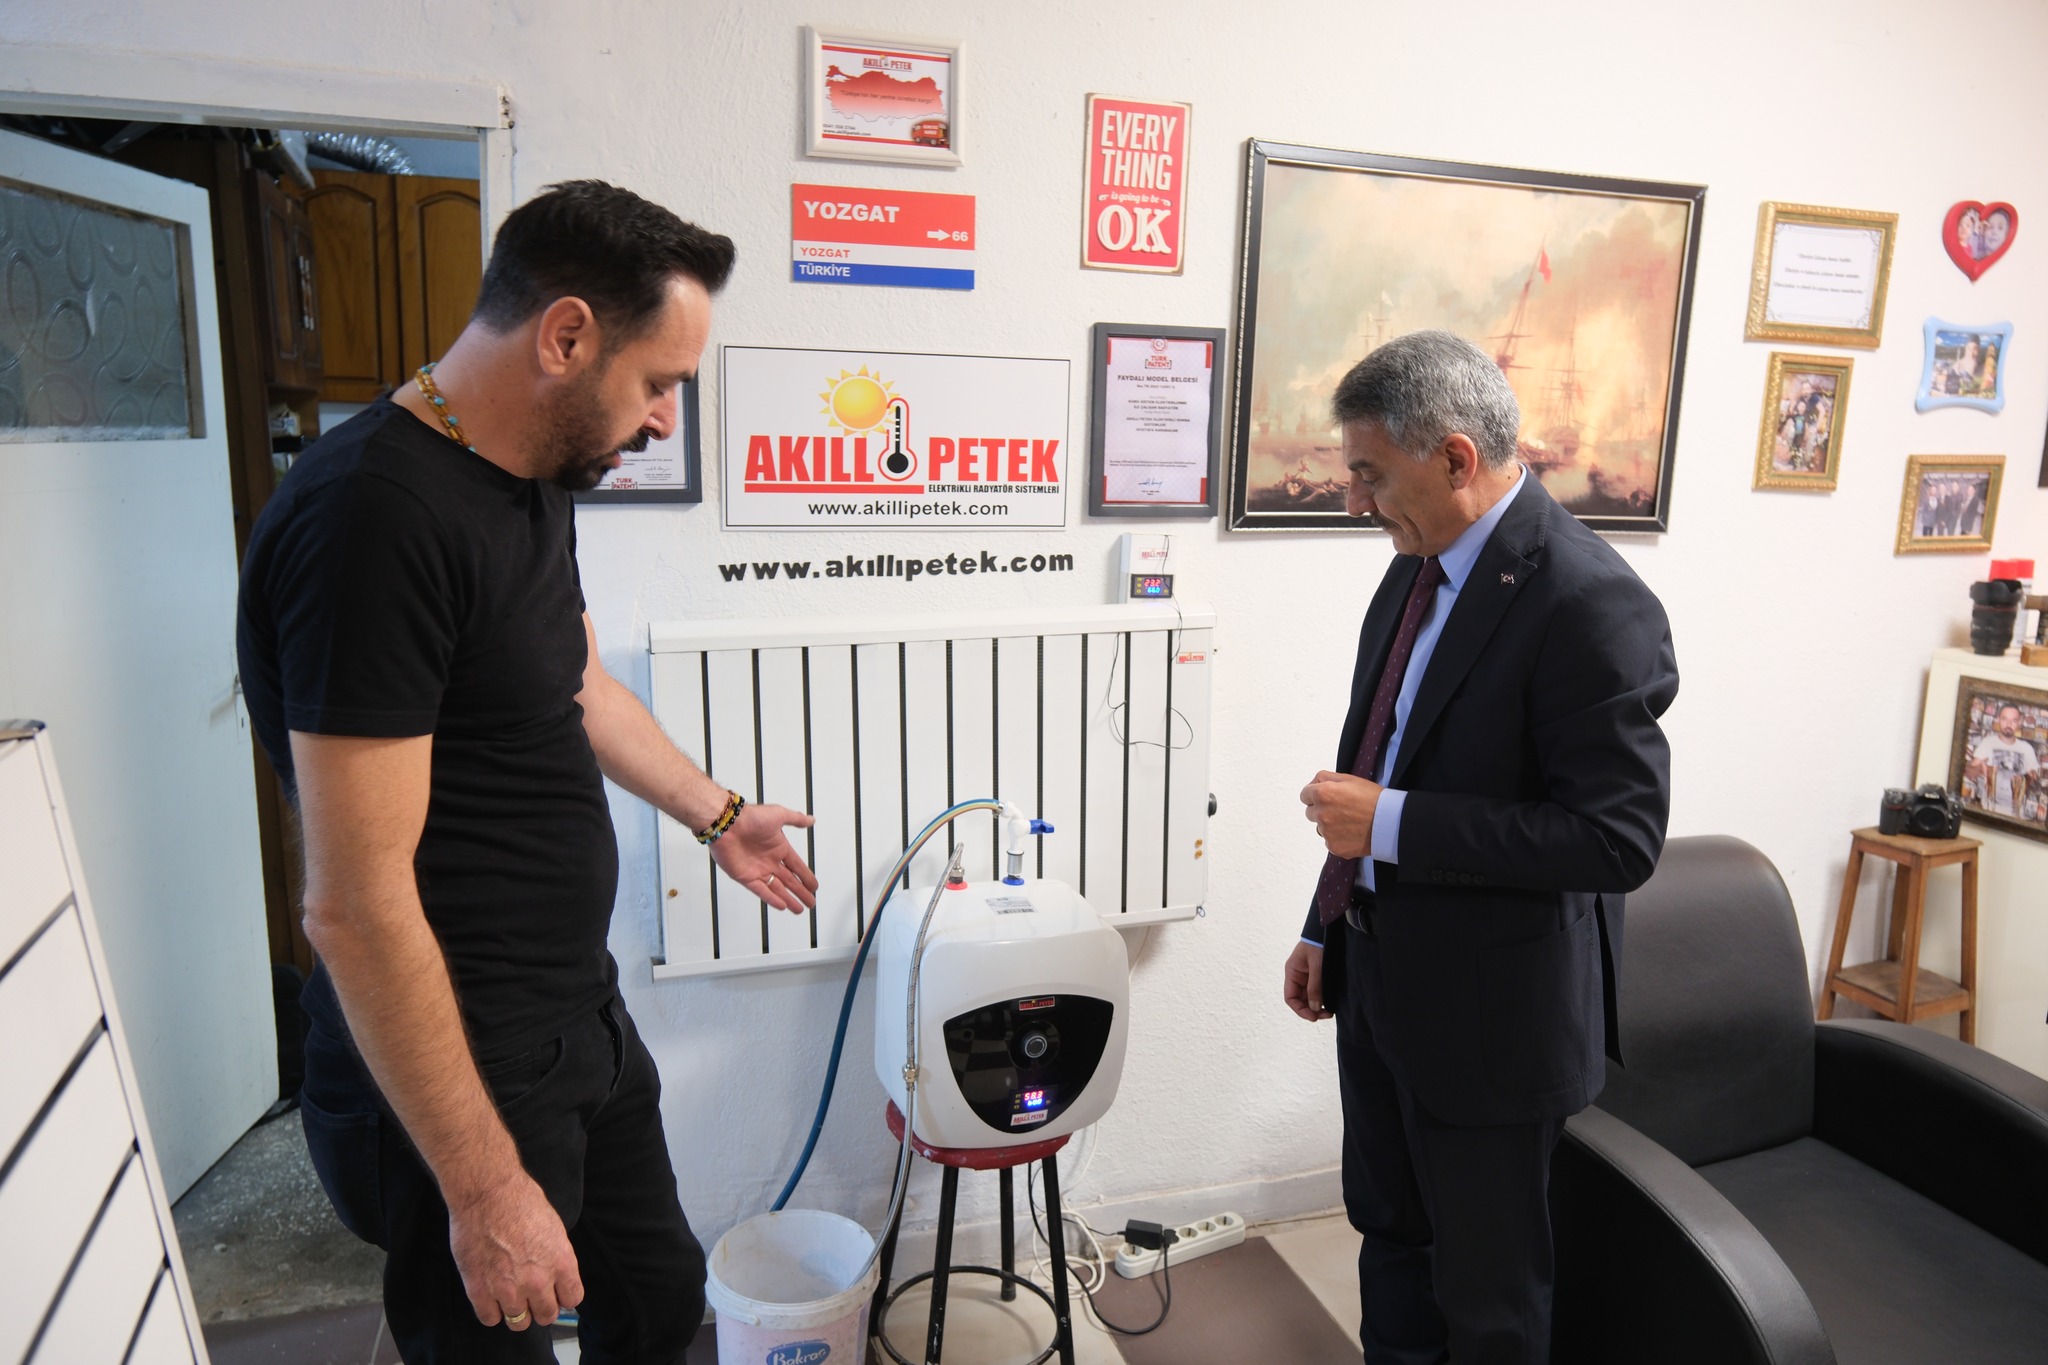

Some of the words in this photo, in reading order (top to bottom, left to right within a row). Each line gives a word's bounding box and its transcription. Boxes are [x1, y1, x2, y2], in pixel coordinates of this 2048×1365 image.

[891, 61, 912, 70] PETEK
[1101, 109, 1177, 152] EVERY
[1101, 149, 1173, 191] THING
[1119, 193, 1141, 204] going
[803, 201, 900, 223] YOZGAT
[952, 231, 968, 242] 66
[1097, 204, 1172, 254] OK
[800, 247, 850, 258] YOZGAT
[799, 262, 850, 277] TÜRKİYE
[928, 437, 1060, 483] PETEK
[973, 484, 1013, 493] RADYATÖR
[808, 500, 1008, 518] www.akillipetek.com
